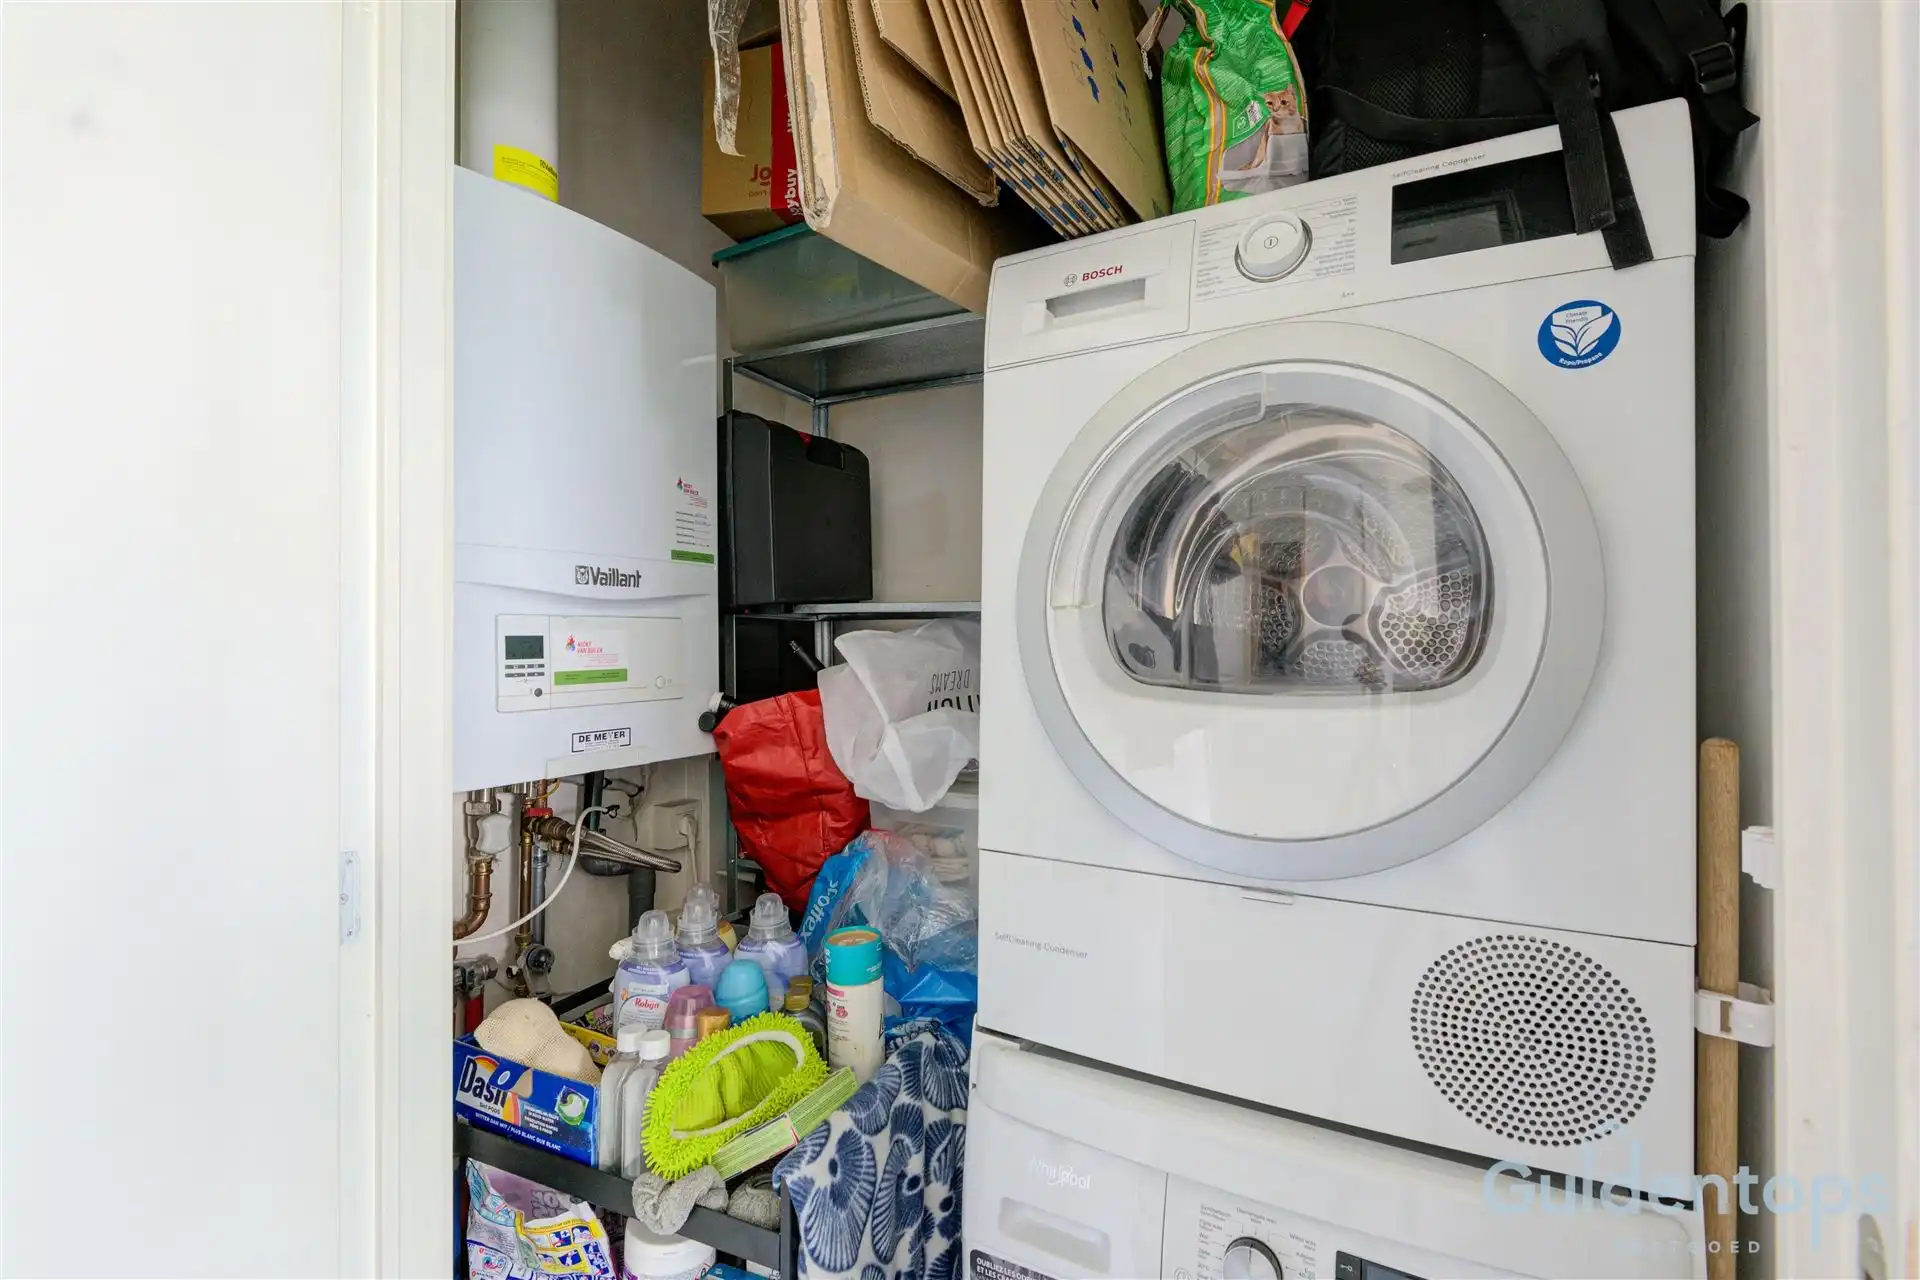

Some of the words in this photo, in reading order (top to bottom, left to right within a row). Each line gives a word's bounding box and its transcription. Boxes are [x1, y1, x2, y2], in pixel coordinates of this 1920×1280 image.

[1082, 264, 1123, 282] BOSCH
[590, 566, 642, 588] Vaillant
[929, 668, 970, 694] DREAMS
[578, 735, 591, 743] DE
[594, 730, 625, 741] MEYER
[634, 997, 660, 1010] Robijn
[490, 1118, 500, 1126] DAN
[510, 1126, 521, 1135] PLUS
[521, 1131, 536, 1141] BLANC
[545, 1140, 561, 1151] BLANC
[976, 1257, 1004, 1273] OUBLIEZ
[1004, 1267, 1016, 1276] LES
[976, 1265, 985, 1273] ET
[985, 1269, 997, 1279] LES
